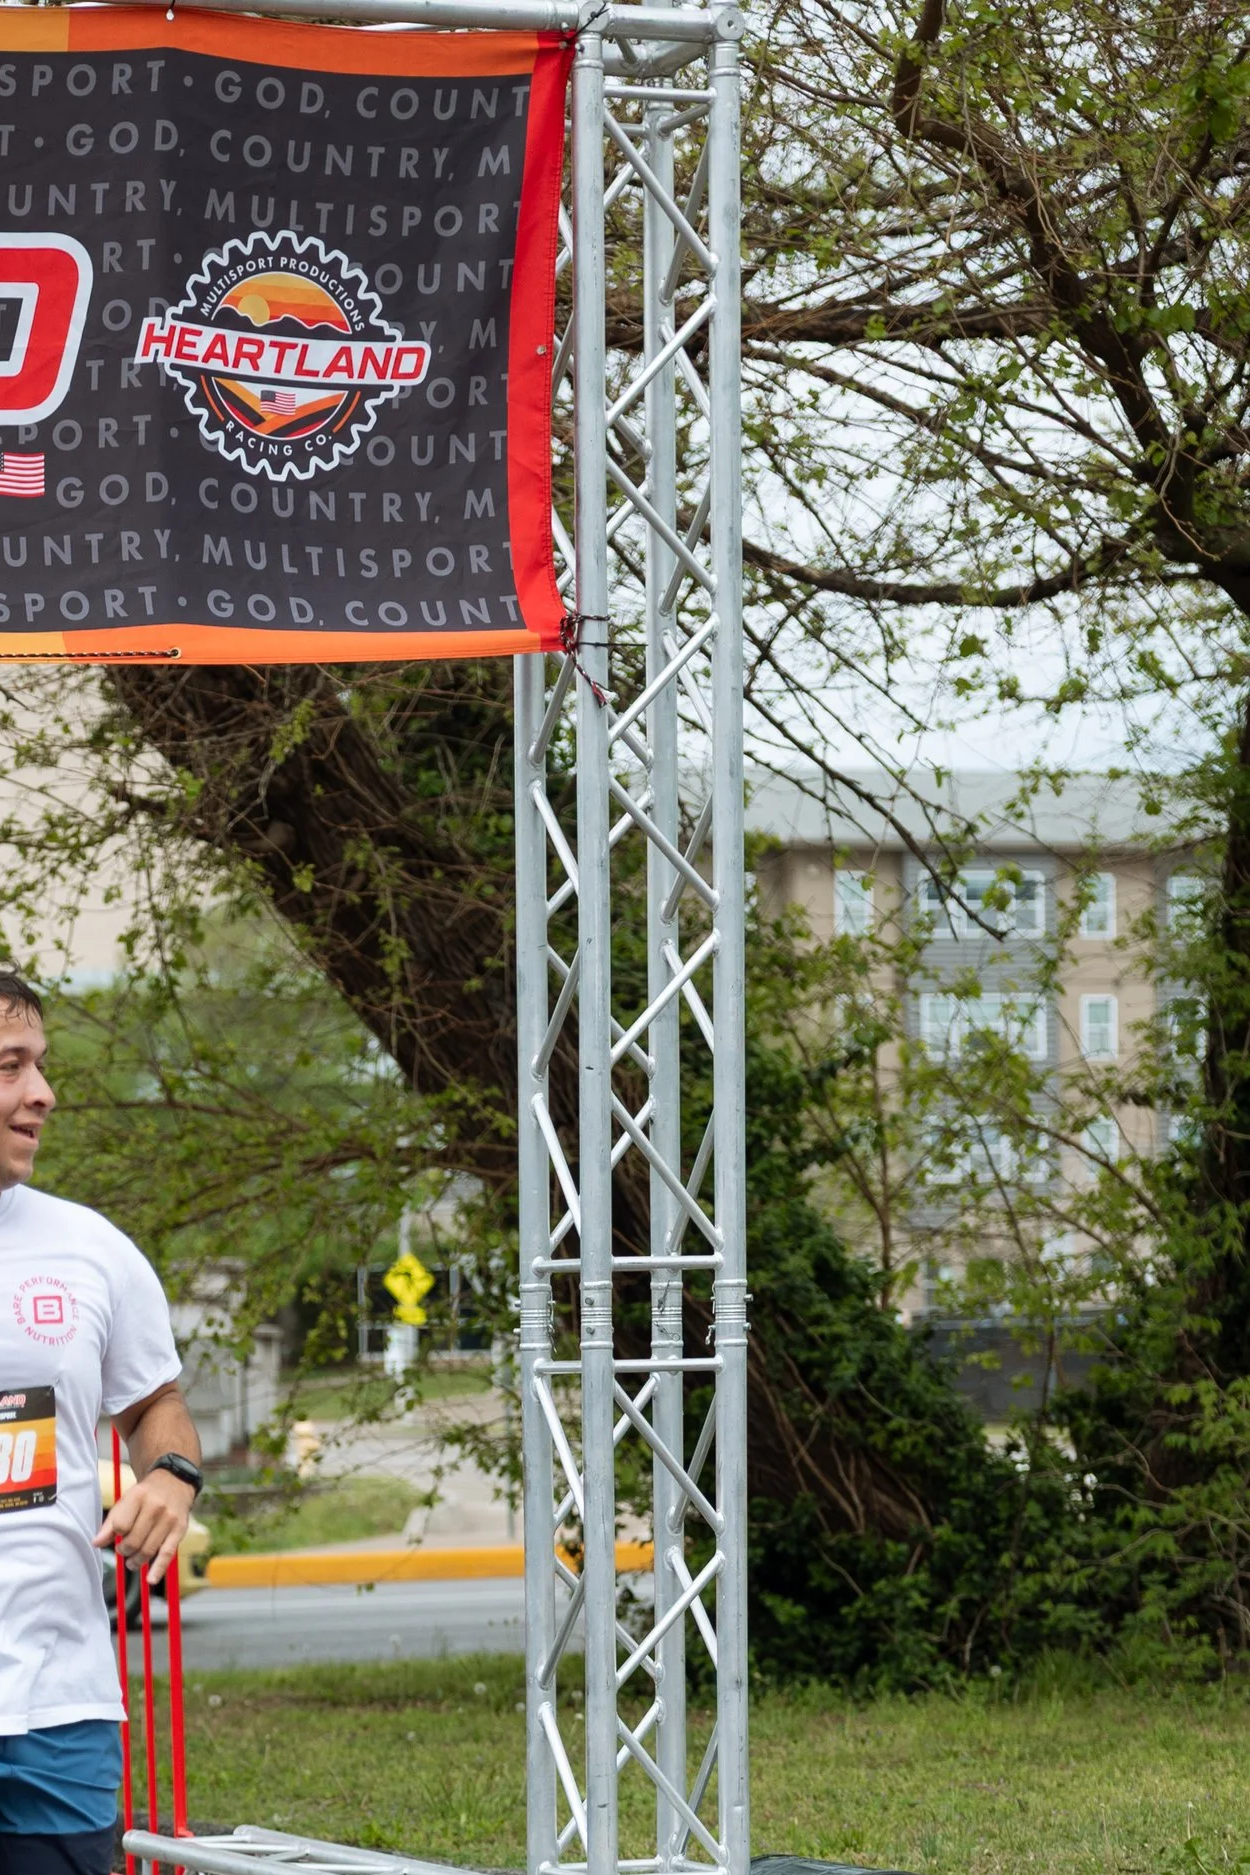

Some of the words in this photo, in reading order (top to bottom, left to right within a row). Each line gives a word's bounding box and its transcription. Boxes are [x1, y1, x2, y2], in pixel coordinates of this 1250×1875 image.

[215, 70, 331, 118] GOD,
[65, 119, 185, 157] GOD,
[210, 129, 454, 180] COUNTRY,
[200, 256, 274, 317] MULTISPORT
[280, 257, 364, 331] PRODUCTIONS
[139, 321, 428, 382] HEARTLAND
[226, 421, 293, 456] RACING
[305, 434, 332, 452] CO.
[56, 471, 176, 508] GOD,
[199, 477, 440, 523] COUNTRY,
[206, 588, 324, 627] GOD,
[13, 1293, 26, 1325] BARE
[24, 1324, 78, 1346] NUTRITION
